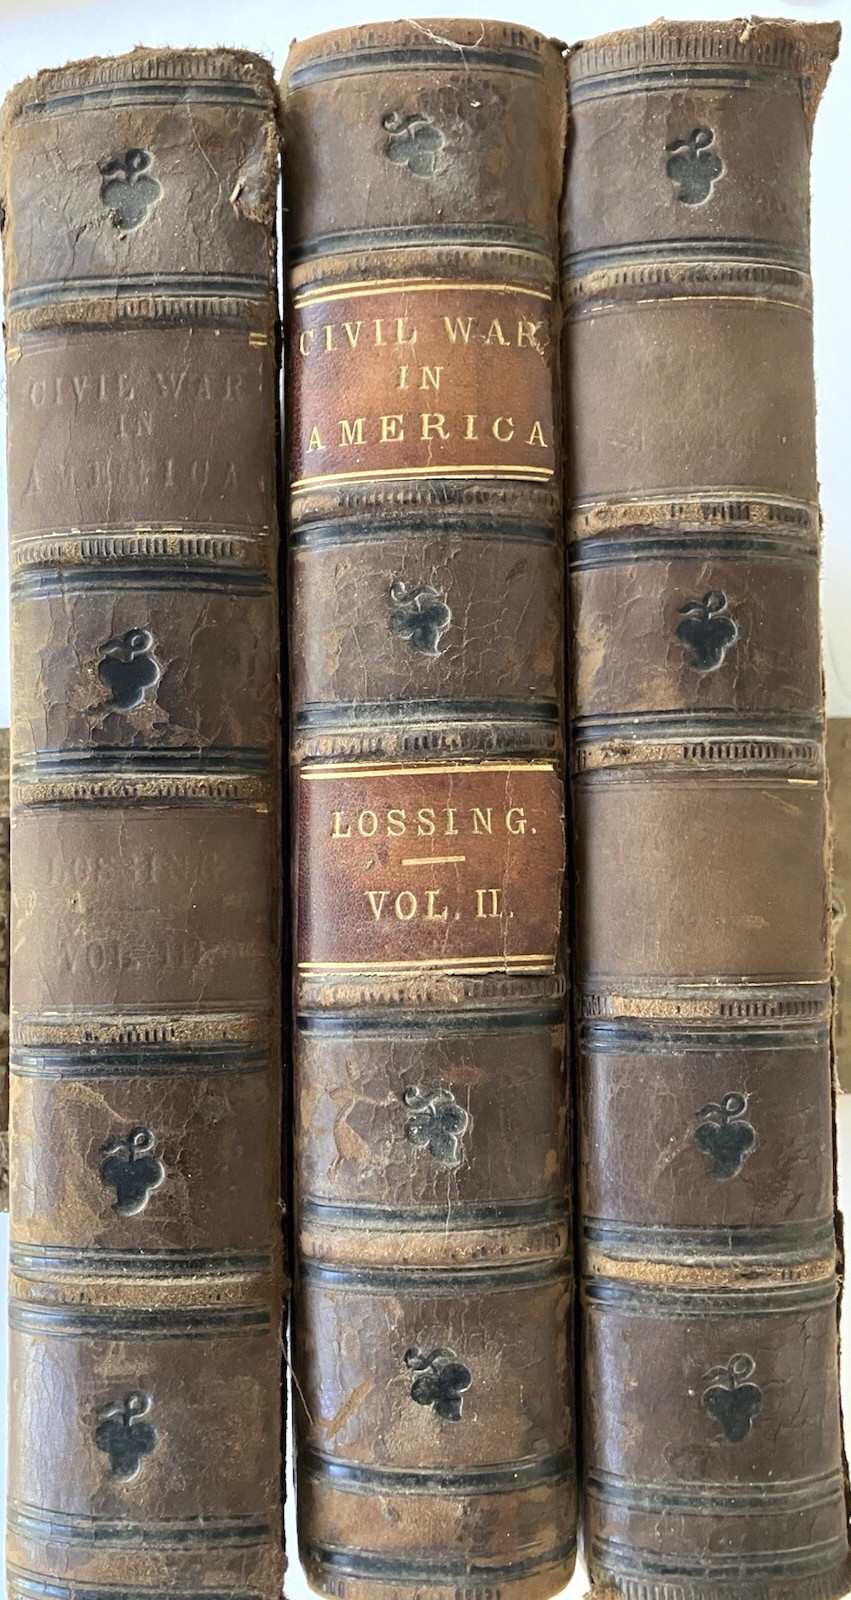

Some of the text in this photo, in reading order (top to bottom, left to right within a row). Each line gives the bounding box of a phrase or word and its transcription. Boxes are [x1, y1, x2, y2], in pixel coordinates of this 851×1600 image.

[300, 316, 546, 357] CIVIL WAR
[396, 365, 444, 391] IN
[306, 413, 548, 453] AMERICA
[331, 807, 537, 838] LOSSING.
[364, 889, 461, 921] VOL.
